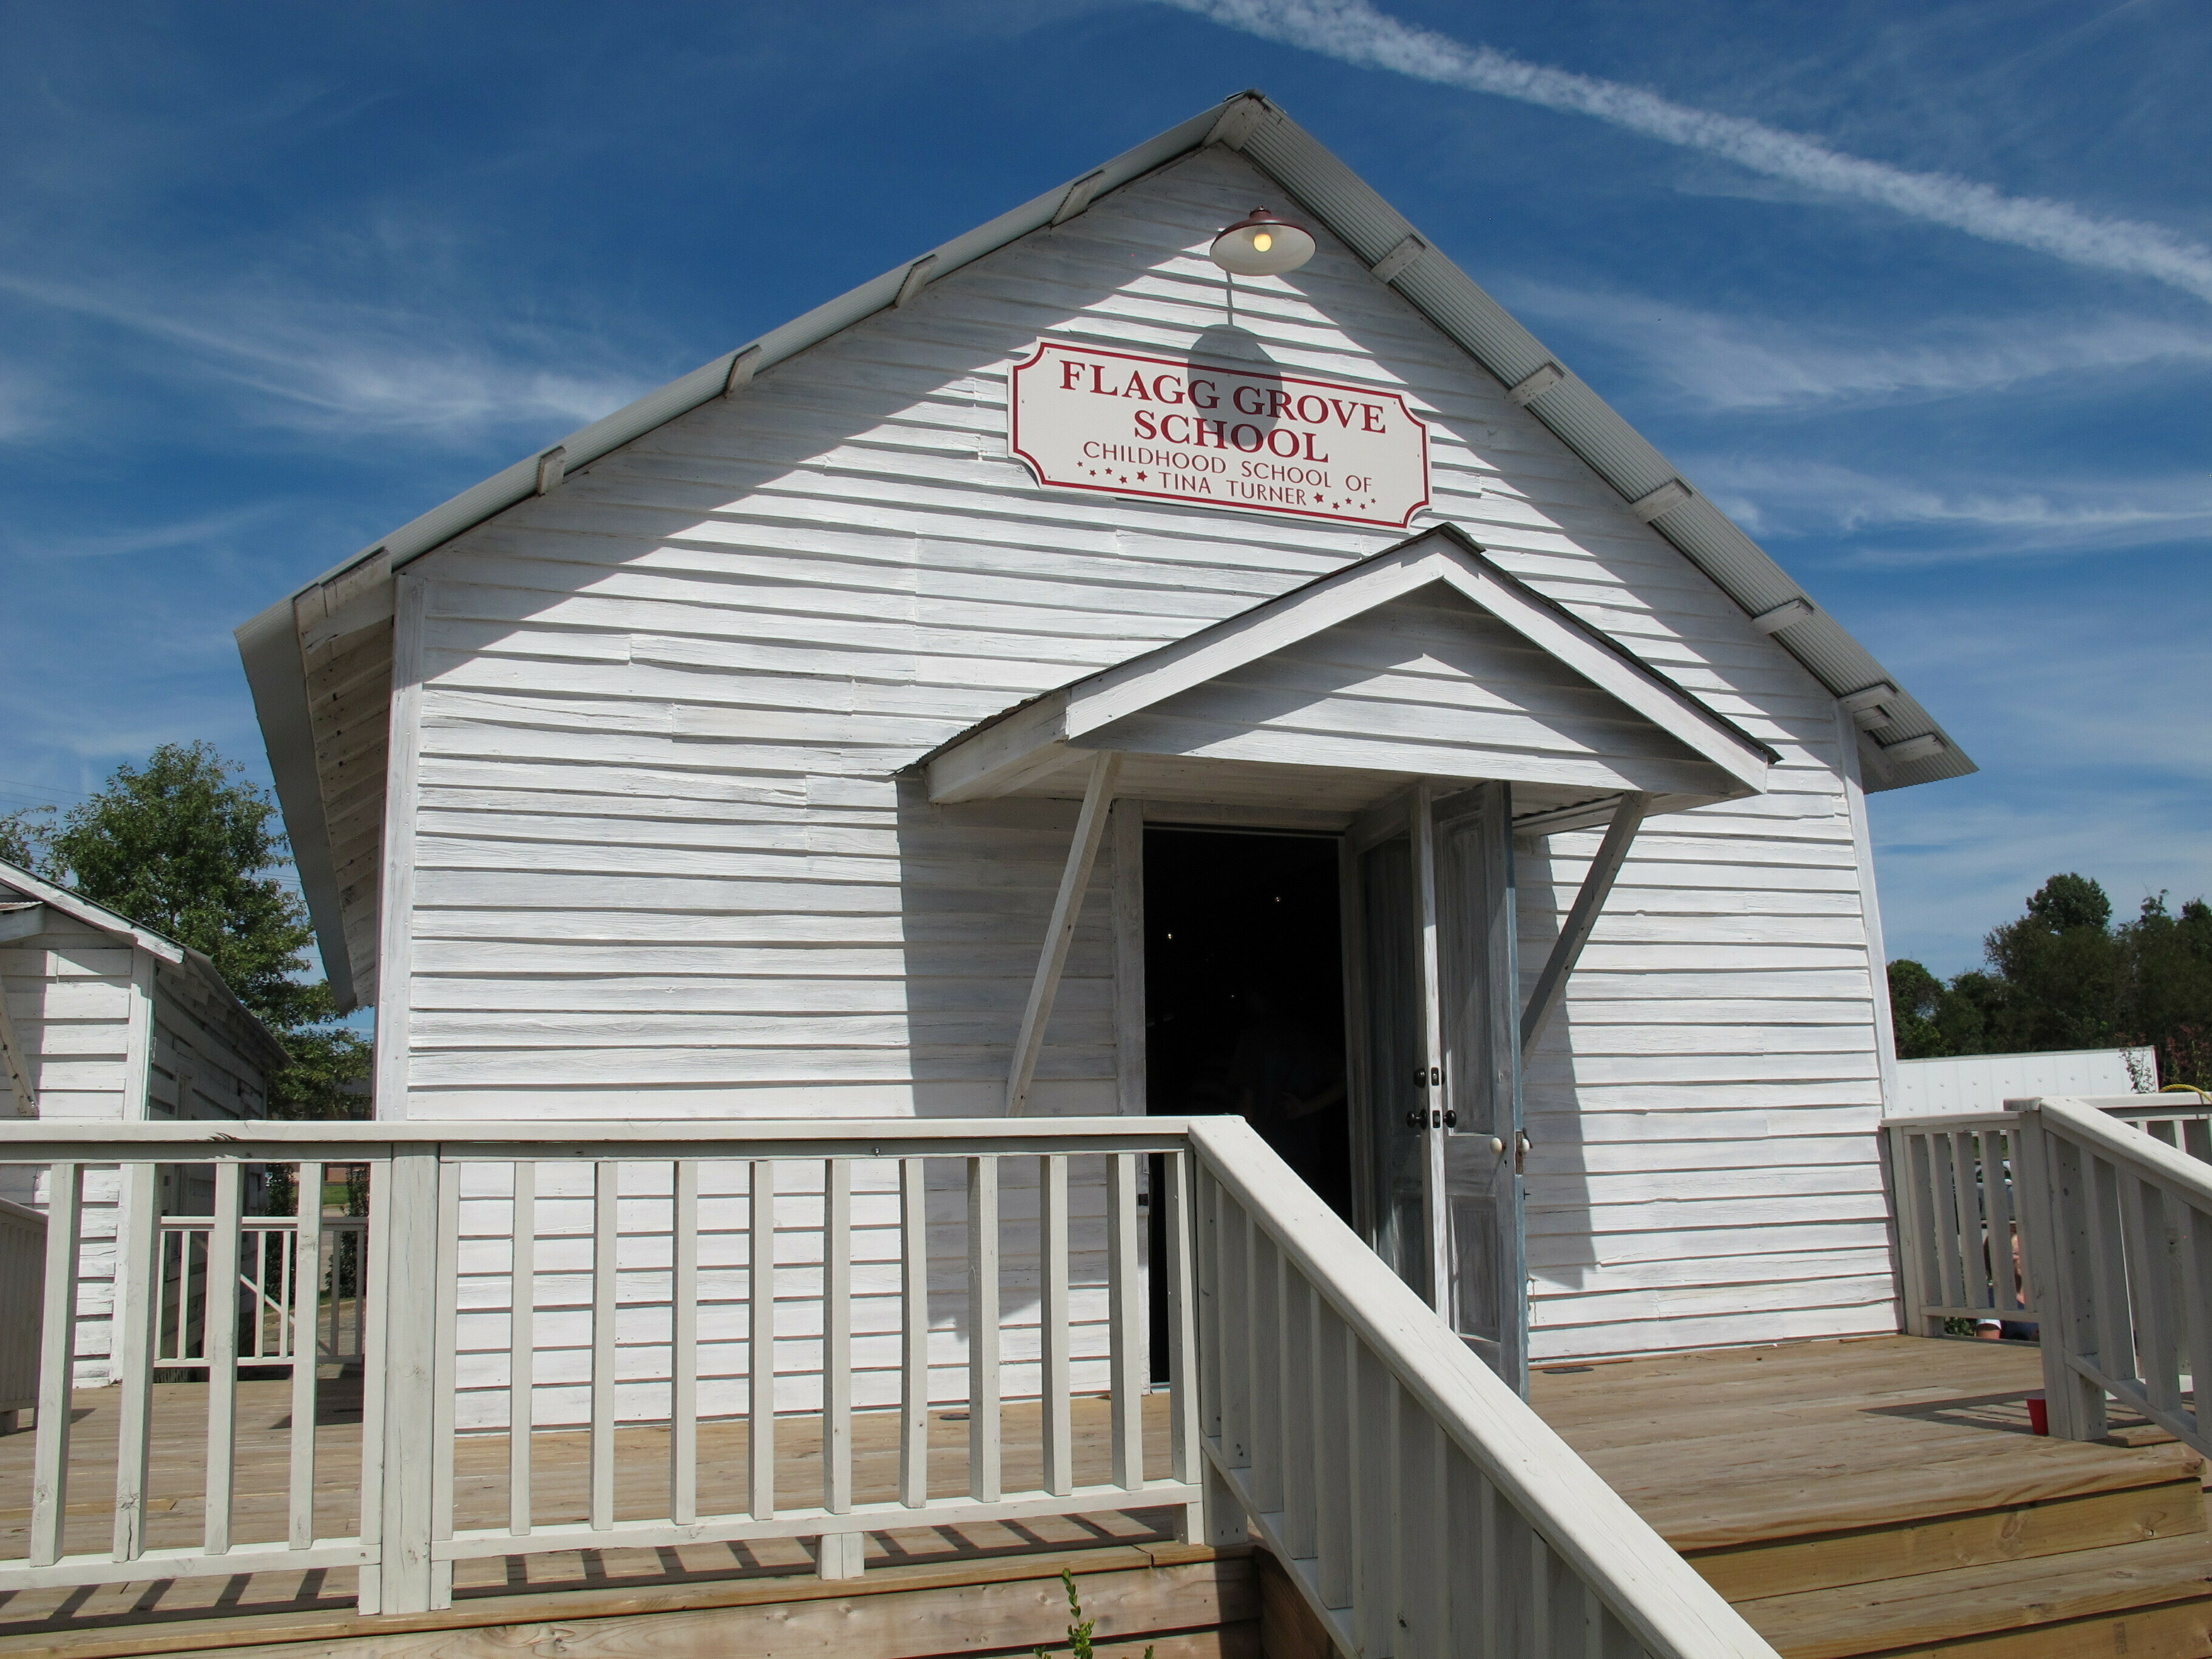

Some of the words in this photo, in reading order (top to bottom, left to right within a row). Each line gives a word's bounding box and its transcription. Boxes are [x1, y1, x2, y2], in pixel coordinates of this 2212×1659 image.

[1060, 360, 1220, 409] FLAGG
[1233, 385, 1386, 434] GROVE
[1134, 410, 1328, 463] SCHOOL
[1083, 441, 1226, 474] CHILDHOOD
[1241, 461, 1331, 488] SCHOOL
[1345, 475, 1372, 493] OF
[1158, 471, 1211, 495] TINA
[1226, 480, 1307, 506] TURNER
